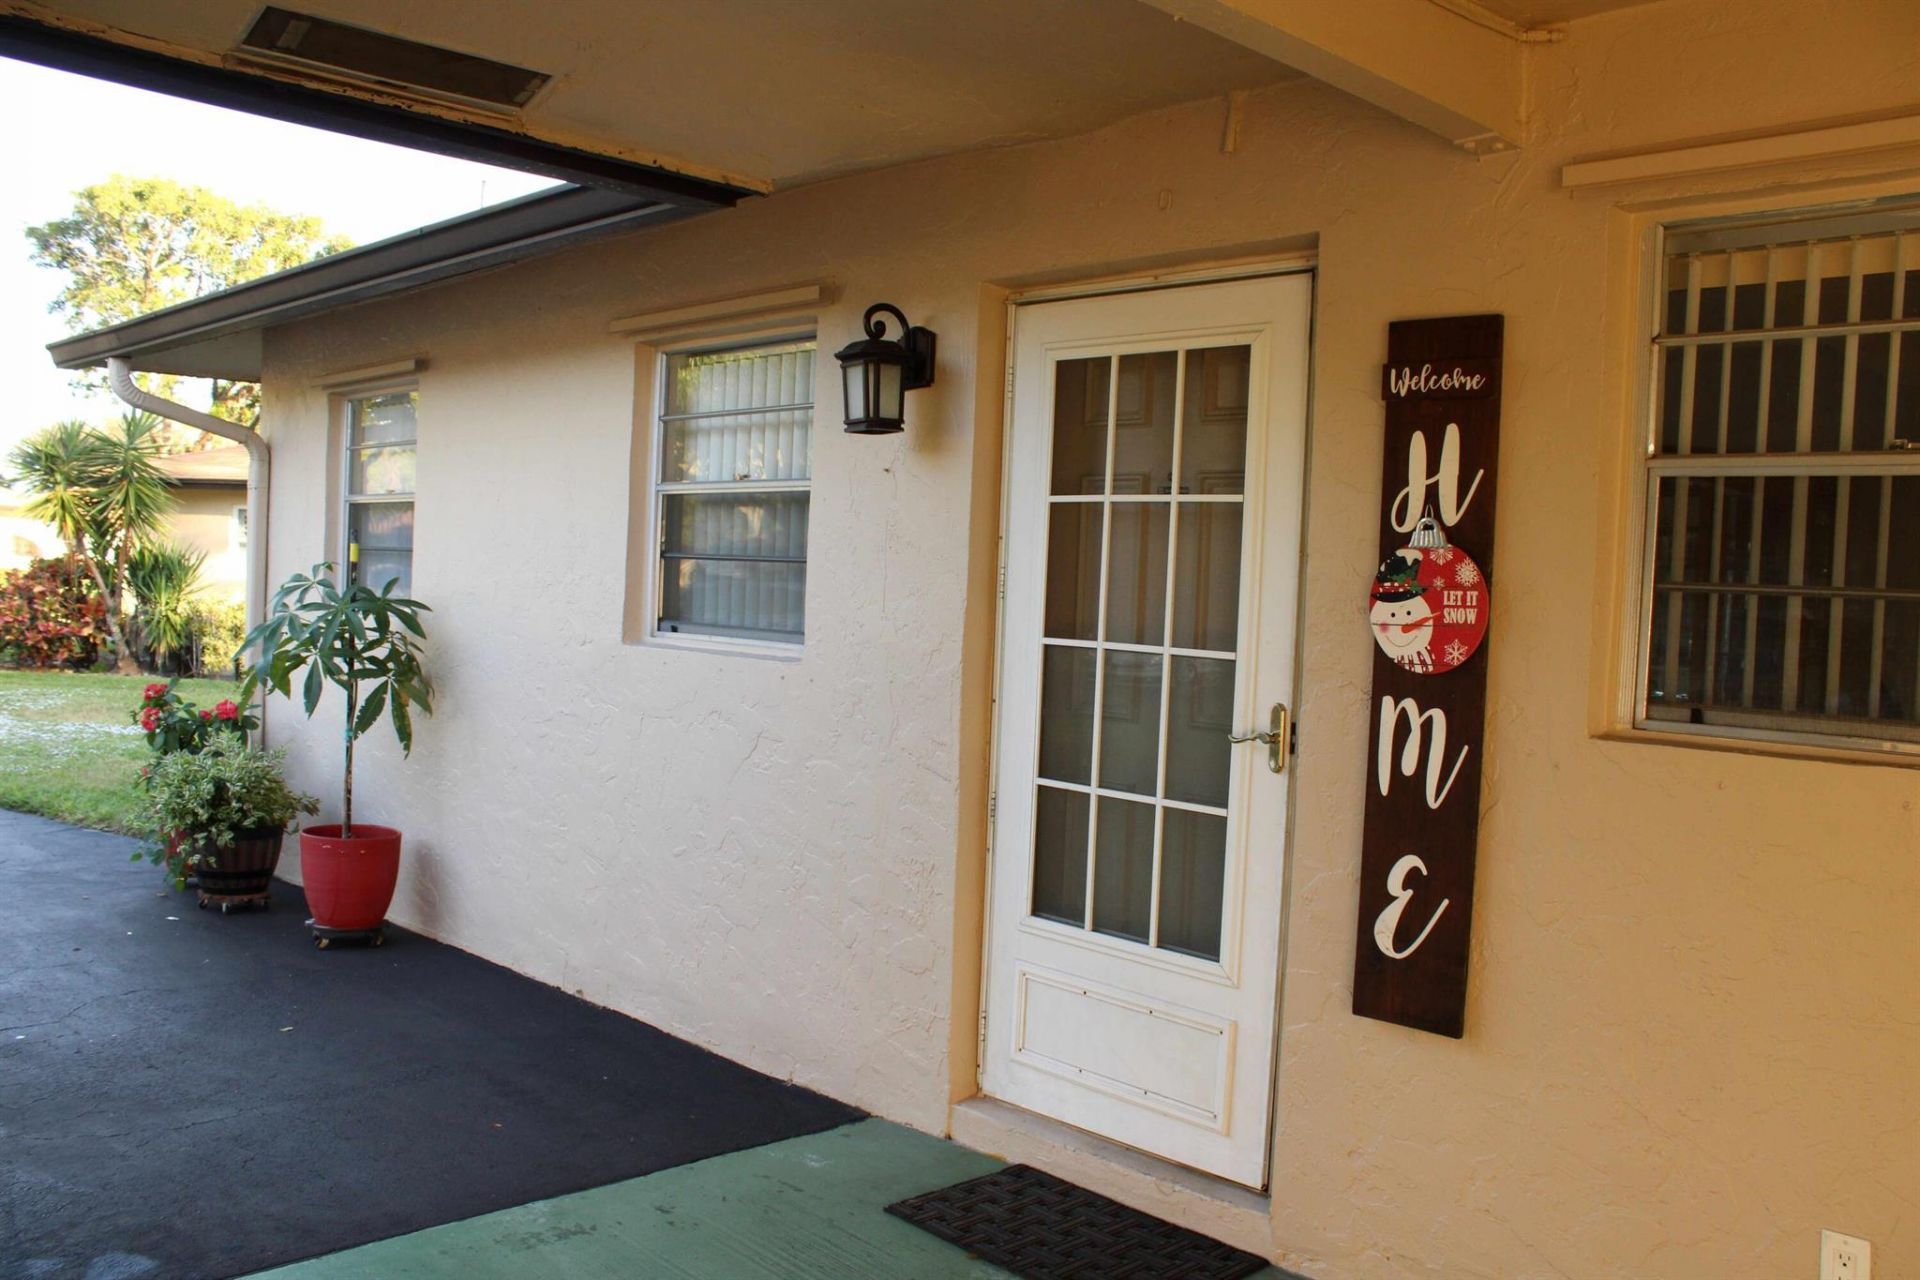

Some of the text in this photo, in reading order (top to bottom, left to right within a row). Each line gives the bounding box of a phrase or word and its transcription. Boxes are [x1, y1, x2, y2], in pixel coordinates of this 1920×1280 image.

[1390, 364, 1486, 398] Welcome
[1443, 590, 1479, 606] LET IT
[1443, 607, 1477, 624] SNOW
